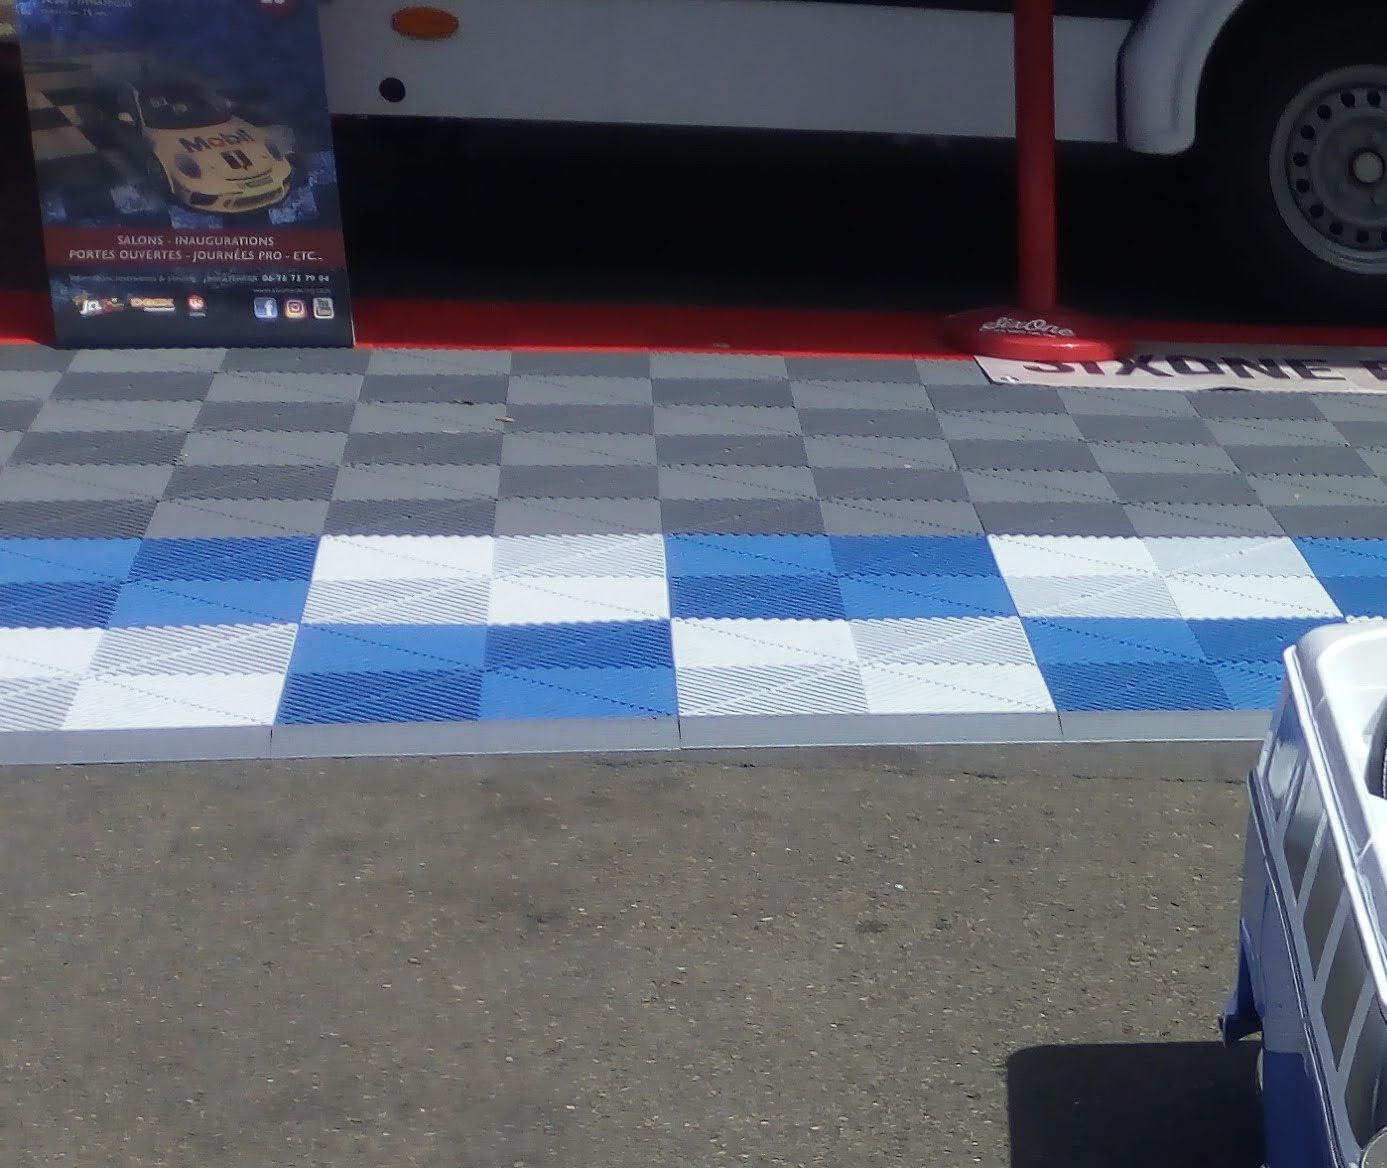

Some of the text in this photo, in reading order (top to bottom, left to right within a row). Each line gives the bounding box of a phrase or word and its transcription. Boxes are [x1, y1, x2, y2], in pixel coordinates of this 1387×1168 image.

[117, 234, 164, 246] SALONS
[175, 235, 275, 247] INAUGURATIONS
[69, 248, 116, 260] PORTES
[119, 249, 182, 261] OUVERTES
[192, 247, 256, 263] JOURNÉES
[258, 250, 282, 261] PRO
